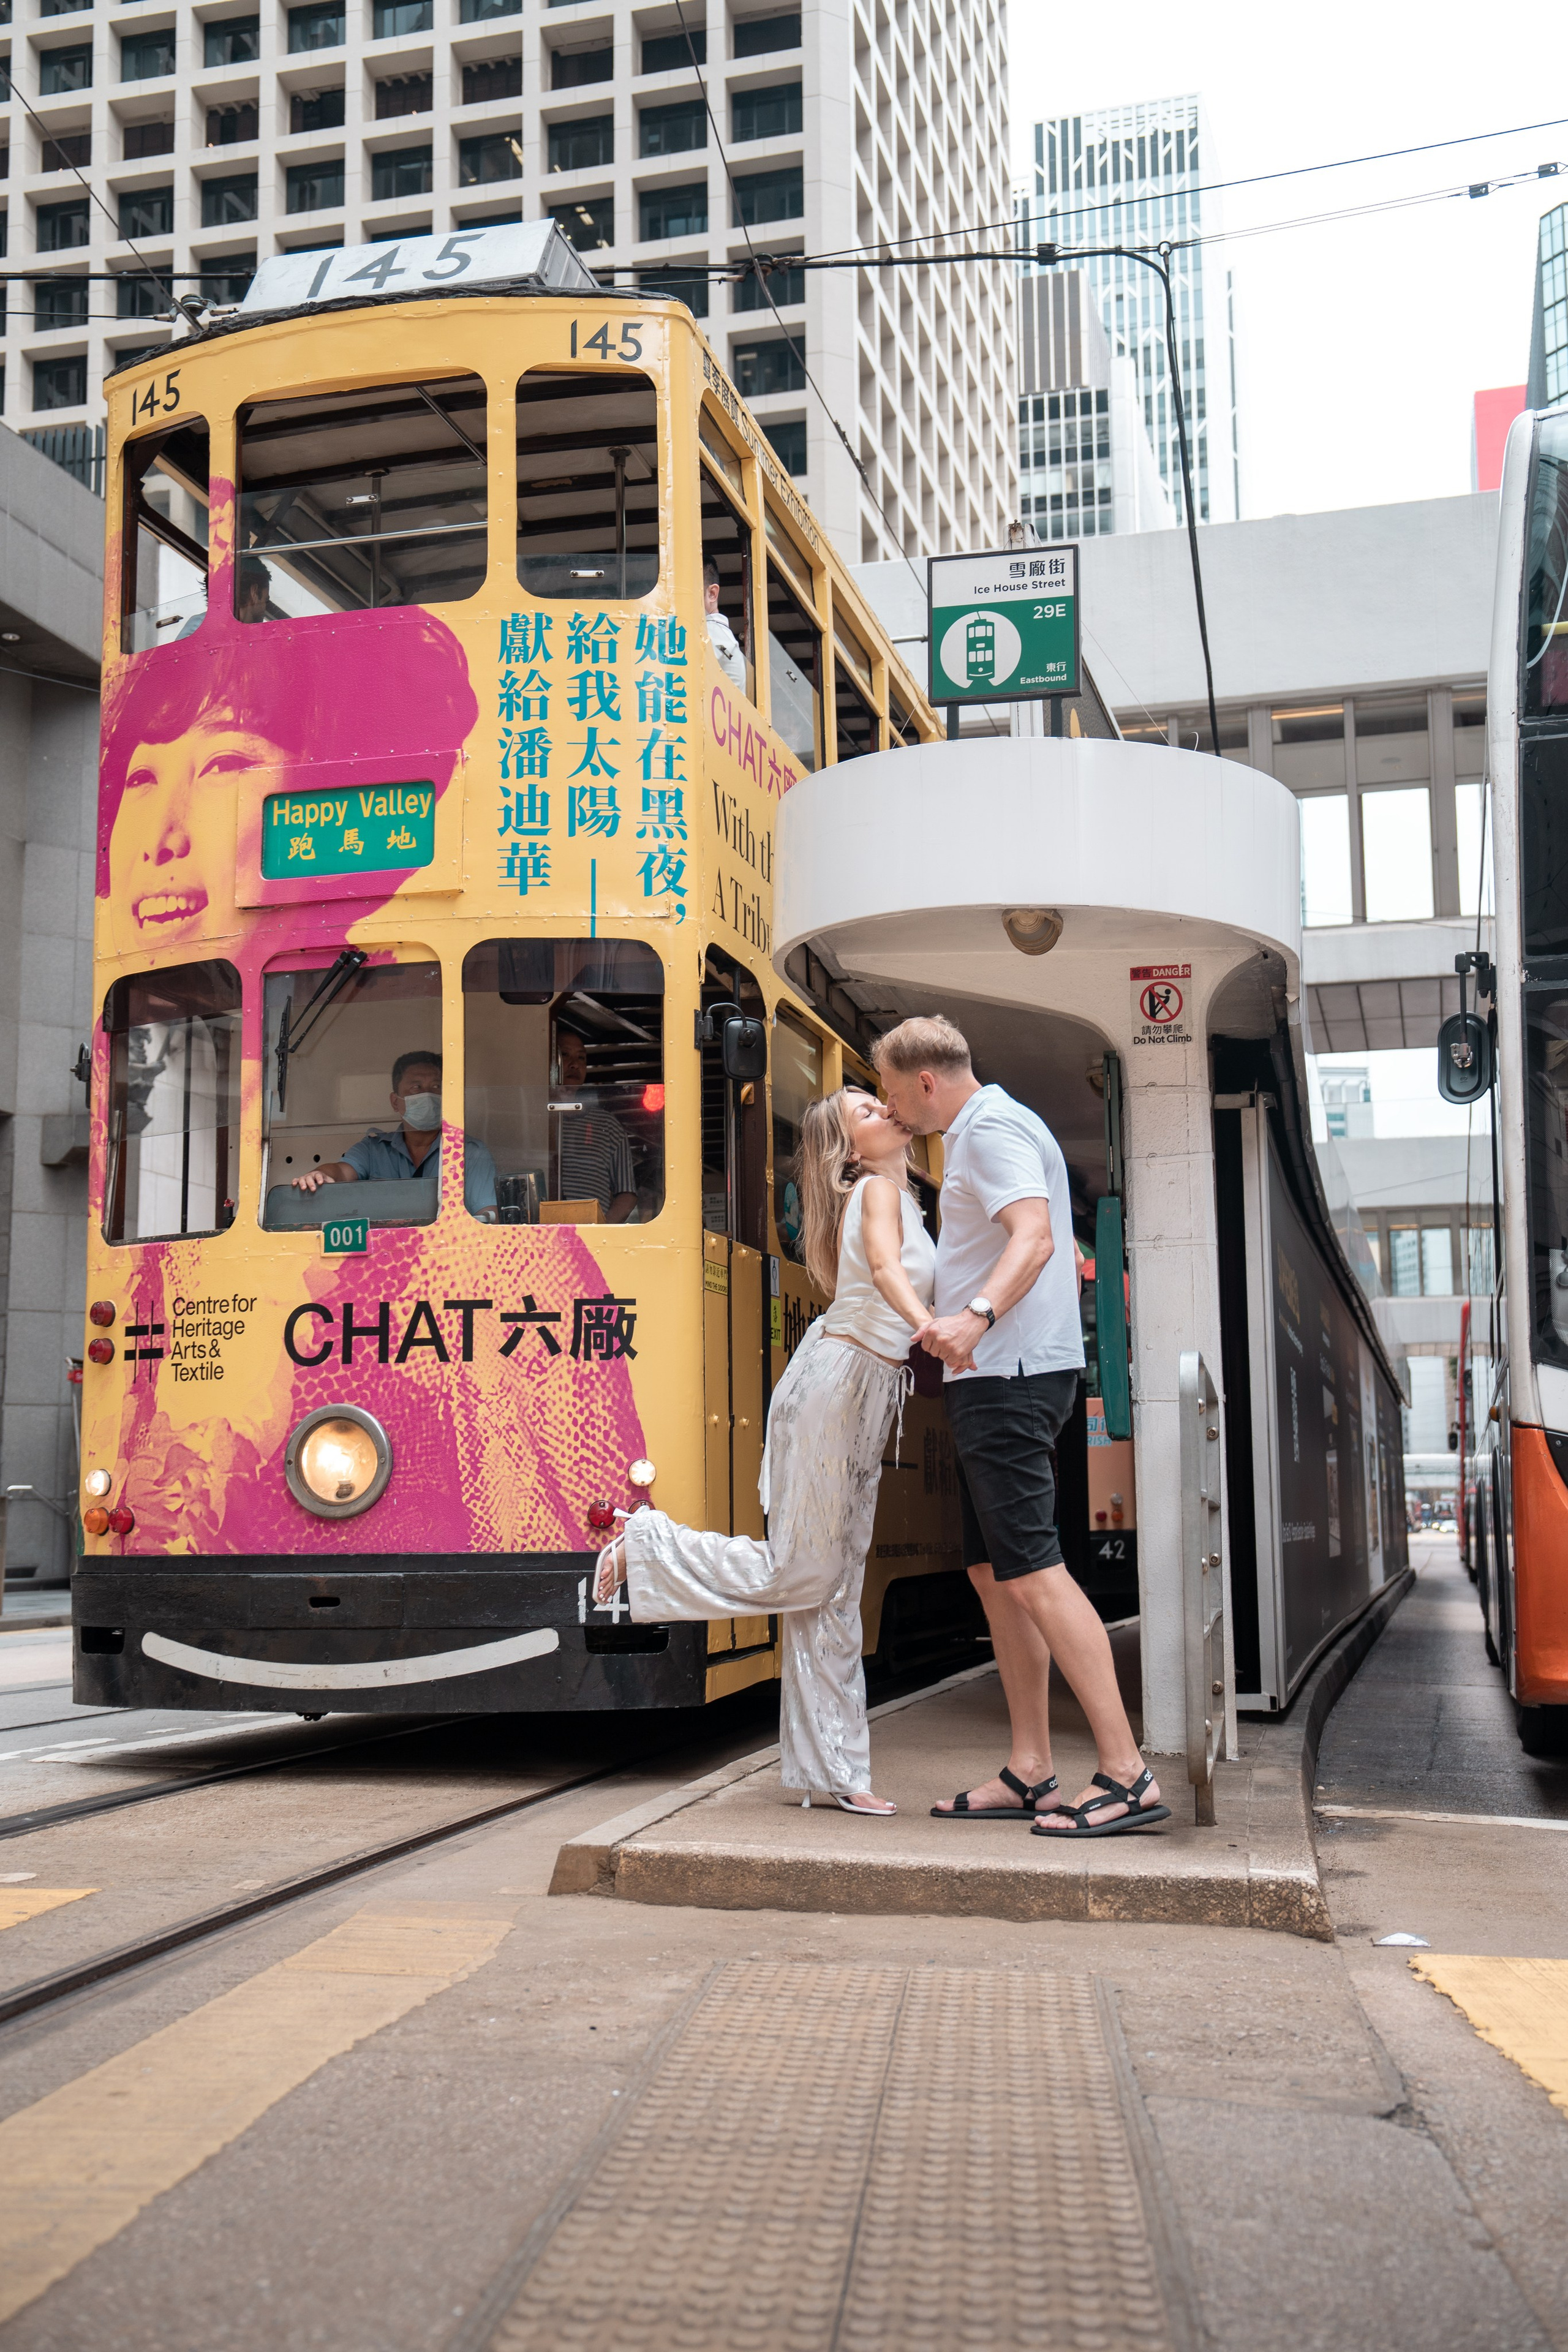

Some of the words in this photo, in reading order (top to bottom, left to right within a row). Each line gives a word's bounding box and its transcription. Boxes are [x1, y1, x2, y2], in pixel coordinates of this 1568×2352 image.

[306, 233, 487, 298] 145
[570, 319, 644, 362] 145
[132, 369, 181, 426] 145
[741, 411, 778, 488] Summer
[781, 473, 820, 554] Exhibition
[1009, 558, 1065, 578] 雪廠街
[974, 586, 990, 594] Ice
[993, 584, 1028, 592] House
[1031, 578, 1066, 589] Street
[1033, 603, 1066, 619] 29E
[1046, 662, 1066, 673] 東行
[1020, 674, 1067, 684] Eastbound
[497, 613, 553, 897] 獻給潘迪華
[272, 797, 348, 827] Happy
[359, 790, 432, 820] Valley
[712, 779, 756, 872] With
[287, 825, 417, 861] 跑馬地
[712, 867, 726, 922] A
[1132, 968, 1152, 978] 警告
[1142, 1024, 1183, 1035] 請勿攀爬
[1167, 1034, 1191, 1043] Climb
[330, 1226, 363, 1246] 001
[173, 1297, 229, 1316] Centre
[232, 1294, 257, 1313] for
[172, 1317, 244, 1340] Heritage
[771, 1327, 781, 1341] EXIT
[171, 1341, 206, 1360] Arts
[209, 1338, 221, 1358] &
[171, 1361, 224, 1382] Textile
[1098, 1539, 1125, 1559] 42
